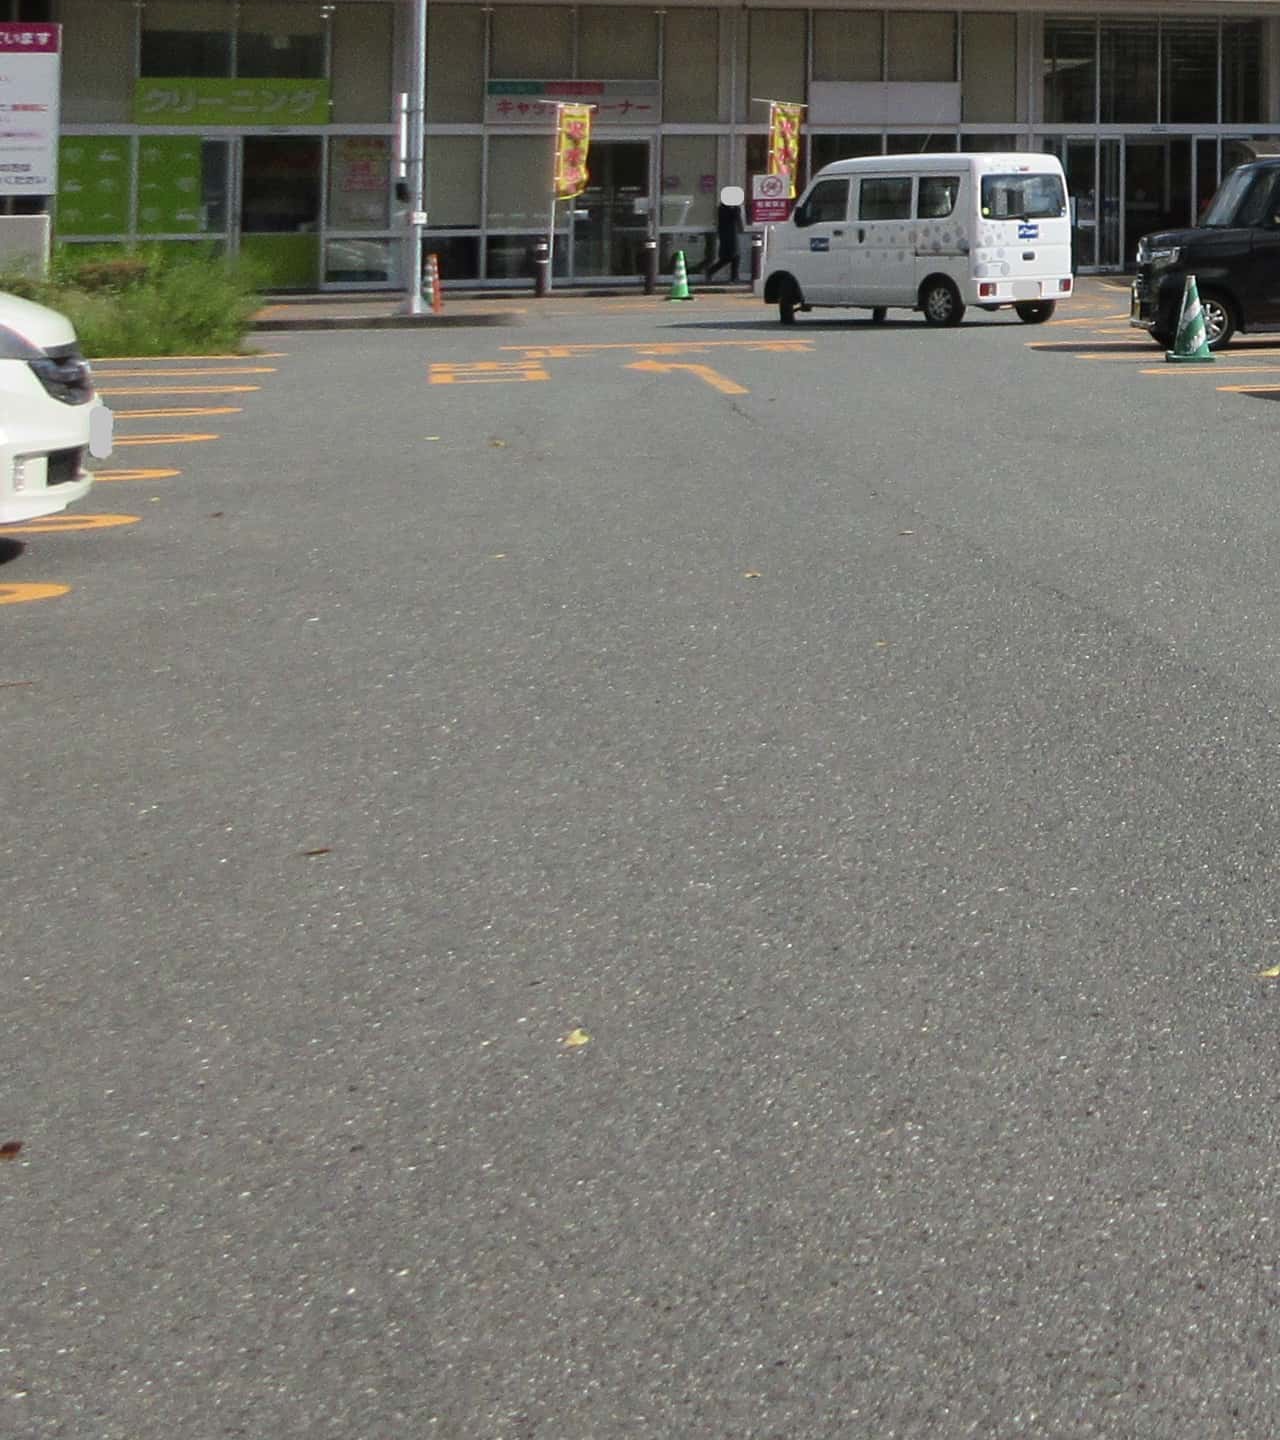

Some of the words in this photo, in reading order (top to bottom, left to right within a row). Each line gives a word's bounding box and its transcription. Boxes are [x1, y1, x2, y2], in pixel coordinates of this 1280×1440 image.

[143, 87, 320, 114] クリーニング
[496, 98, 652, 117] キャッーナー
